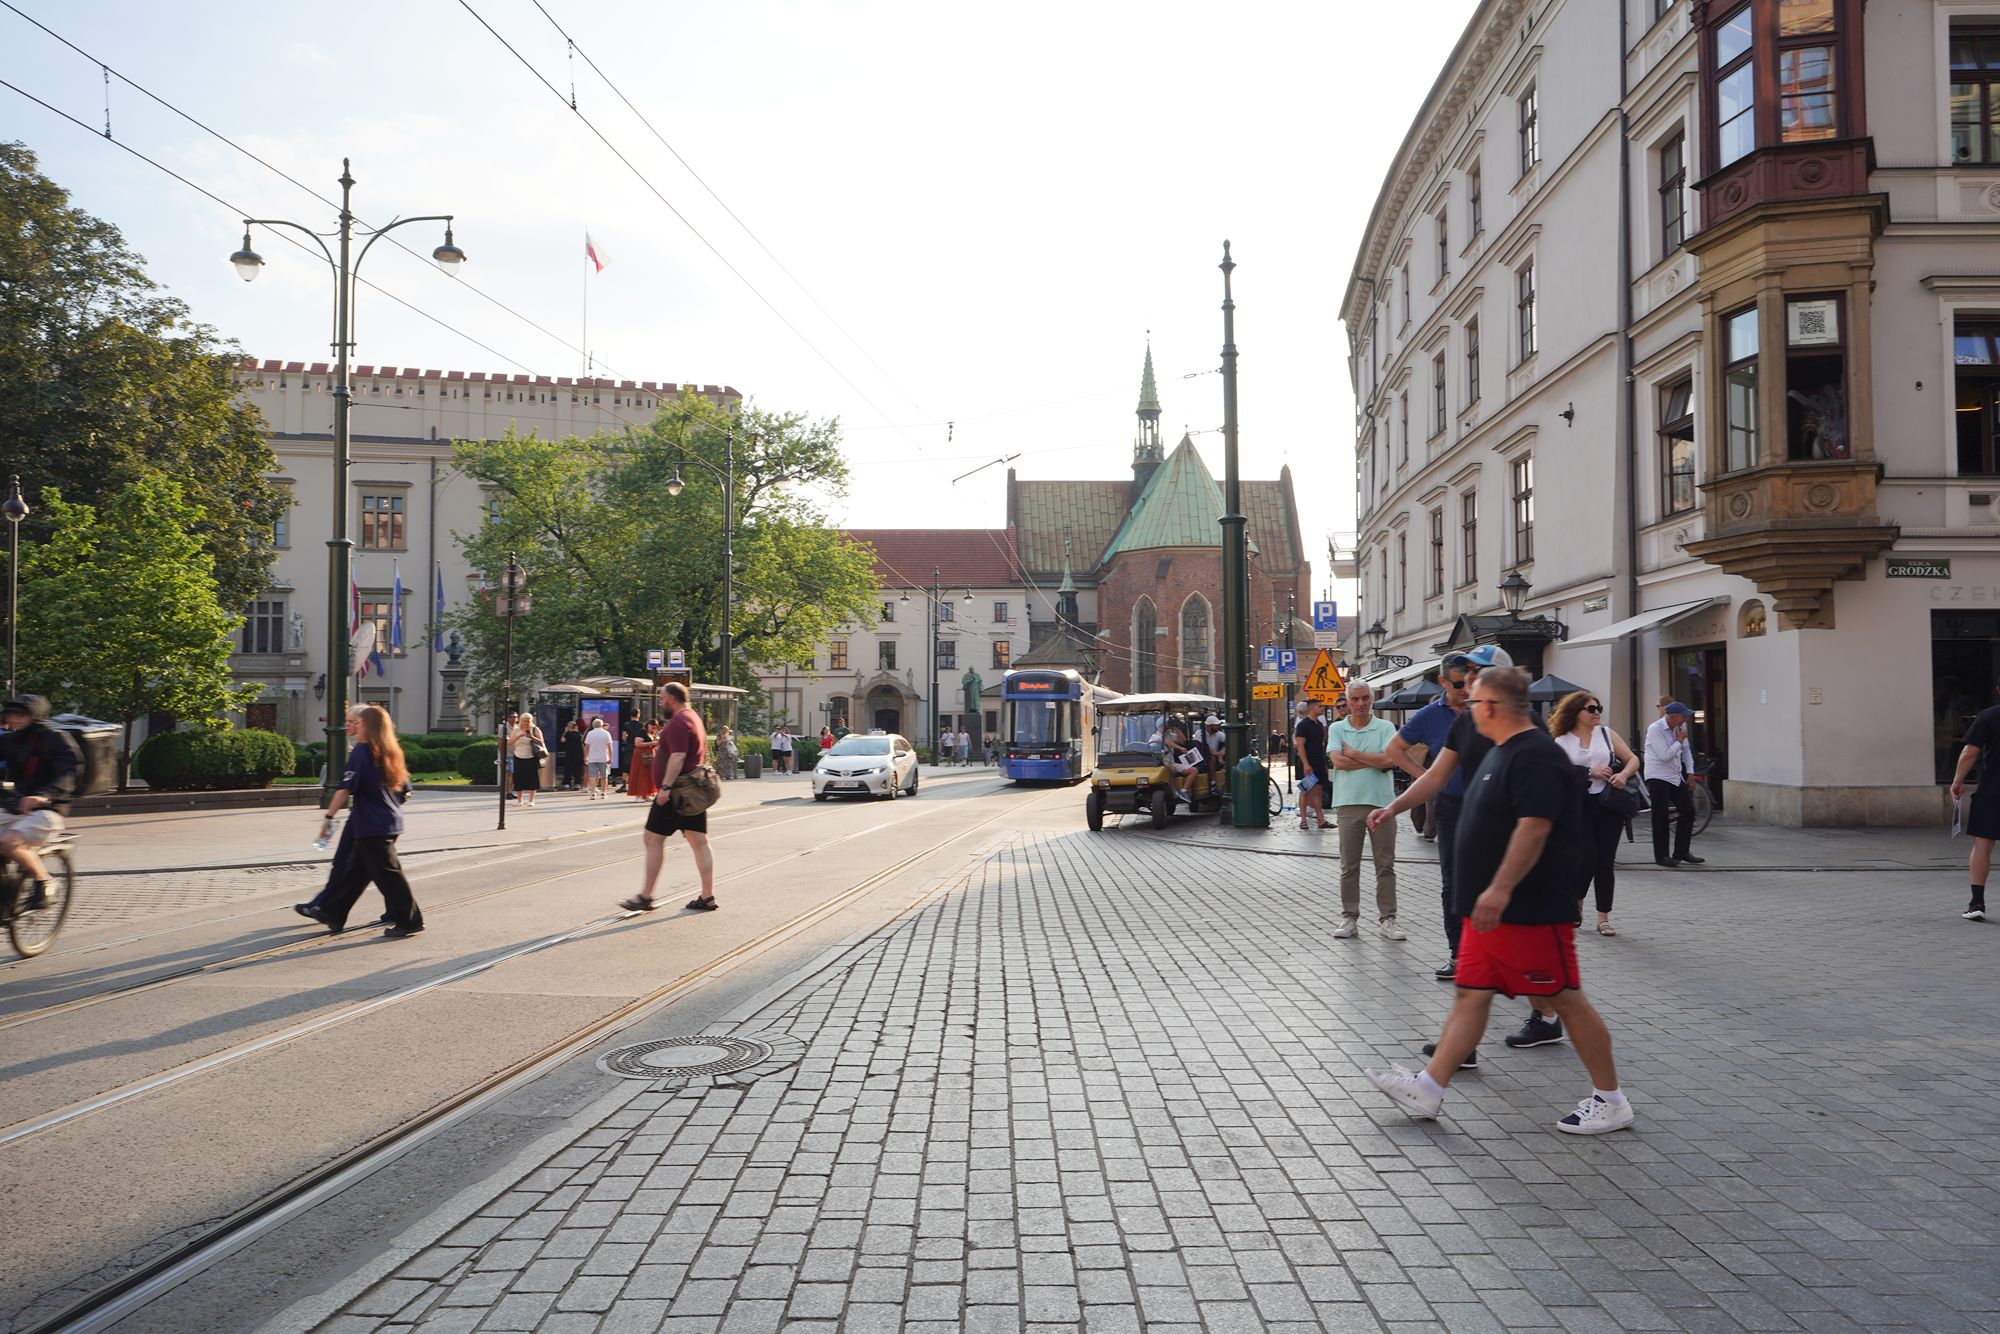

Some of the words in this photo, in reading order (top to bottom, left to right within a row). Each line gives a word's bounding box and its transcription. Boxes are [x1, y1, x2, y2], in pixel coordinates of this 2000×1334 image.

[1888, 566, 1950, 576] GRODZKA
[1319, 603, 1334, 622] P
[1264, 648, 1275, 661] P
[1281, 651, 1293, 667] P
